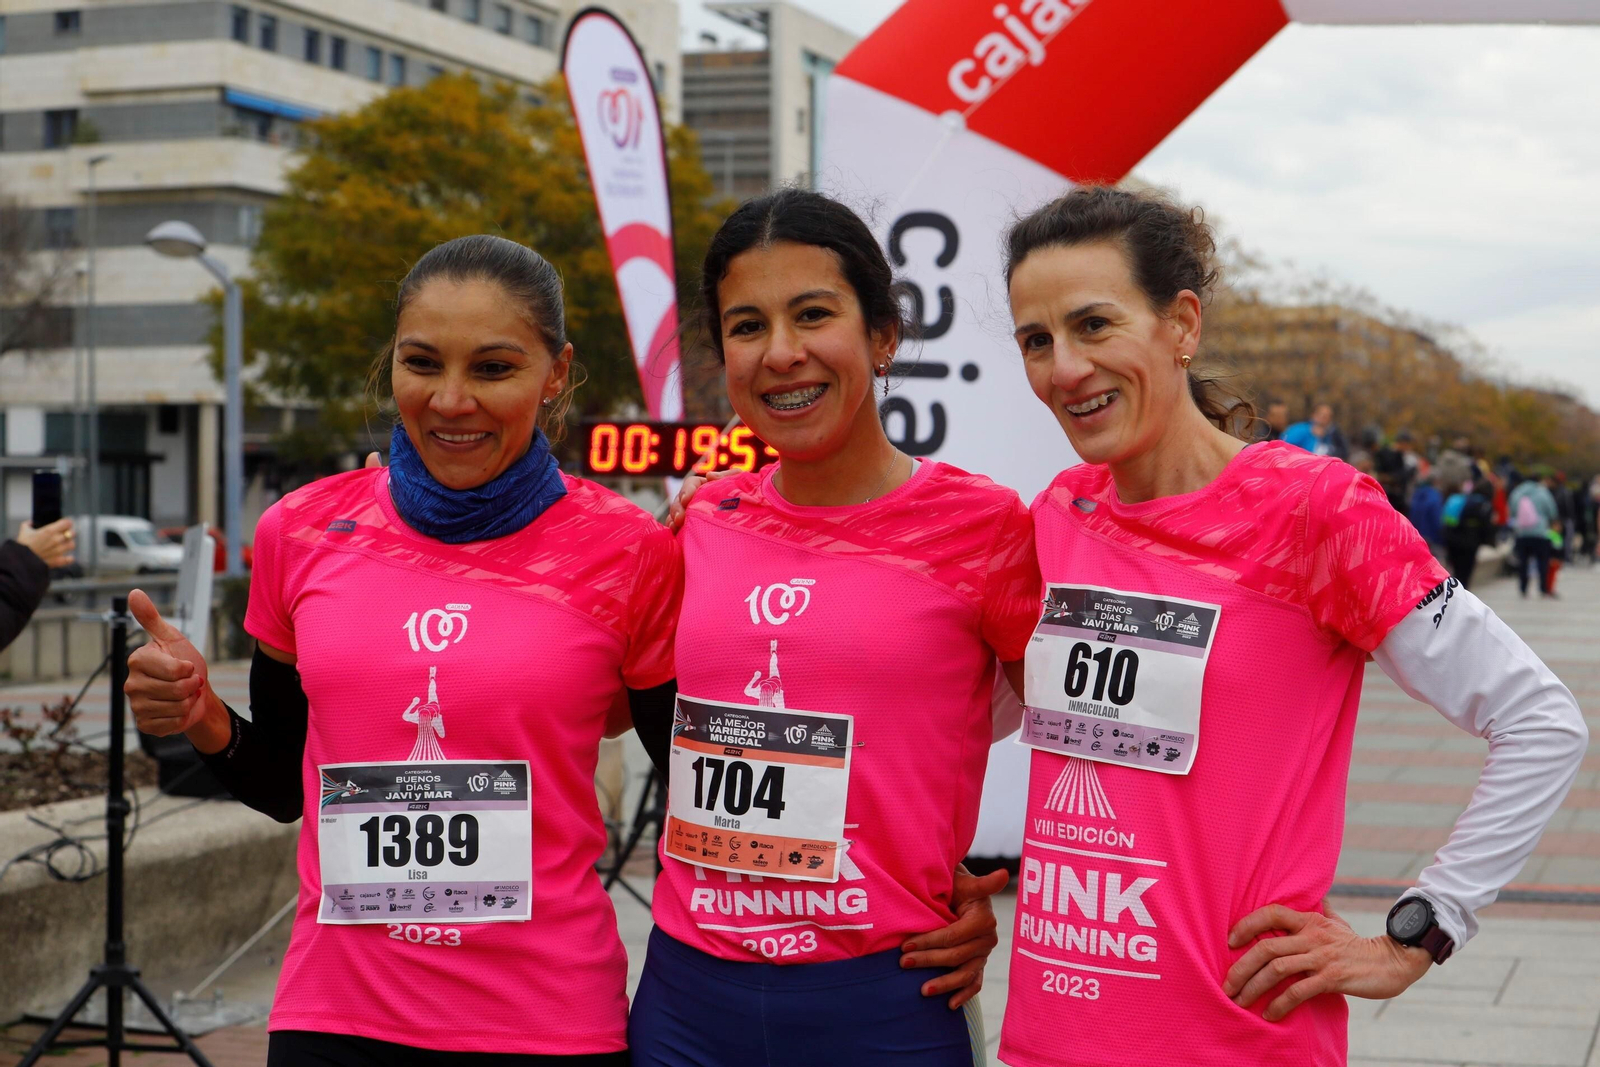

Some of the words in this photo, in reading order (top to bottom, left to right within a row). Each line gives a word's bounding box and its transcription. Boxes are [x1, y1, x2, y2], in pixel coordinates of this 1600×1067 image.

[948, 0, 1093, 103] caja
[590, 424, 779, 474] 00:19:5
[1094, 602, 1133, 615] BUENOS
[1100, 611, 1122, 622] DÍAS
[1082, 618, 1104, 629] JAVI
[1105, 622, 1112, 631] y
[1113, 622, 1139, 634] MAR
[1178, 623, 1200, 632] PINK
[1063, 641, 1139, 706] 610
[1067, 699, 1120, 720] INMACULADA
[708, 724, 766, 739] VARIEDAD
[710, 716, 723, 725] LA
[724, 718, 766, 731] MEJOR
[710, 733, 762, 747] MUSICAL
[811, 735, 835, 743] PINK
[395, 775, 442, 784] BUENOS
[406, 783, 431, 791] DÍAS
[385, 792, 412, 800] JAVI
[415, 793, 422, 801] y
[424, 791, 452, 799] MAR
[691, 756, 786, 820] 1704
[713, 815, 741, 830] Marta
[360, 813, 479, 868] 1389
[1034, 818, 1054, 837] VIII
[1057, 823, 1135, 849] EDICIÓN
[408, 869, 428, 880] Lisa
[1022, 856, 1160, 928] PINK
[690, 887, 868, 917] RUNNING
[386, 923, 462, 947] 2023
[1019, 912, 1158, 962] RUNNING
[1042, 970, 1100, 1000] 2023
